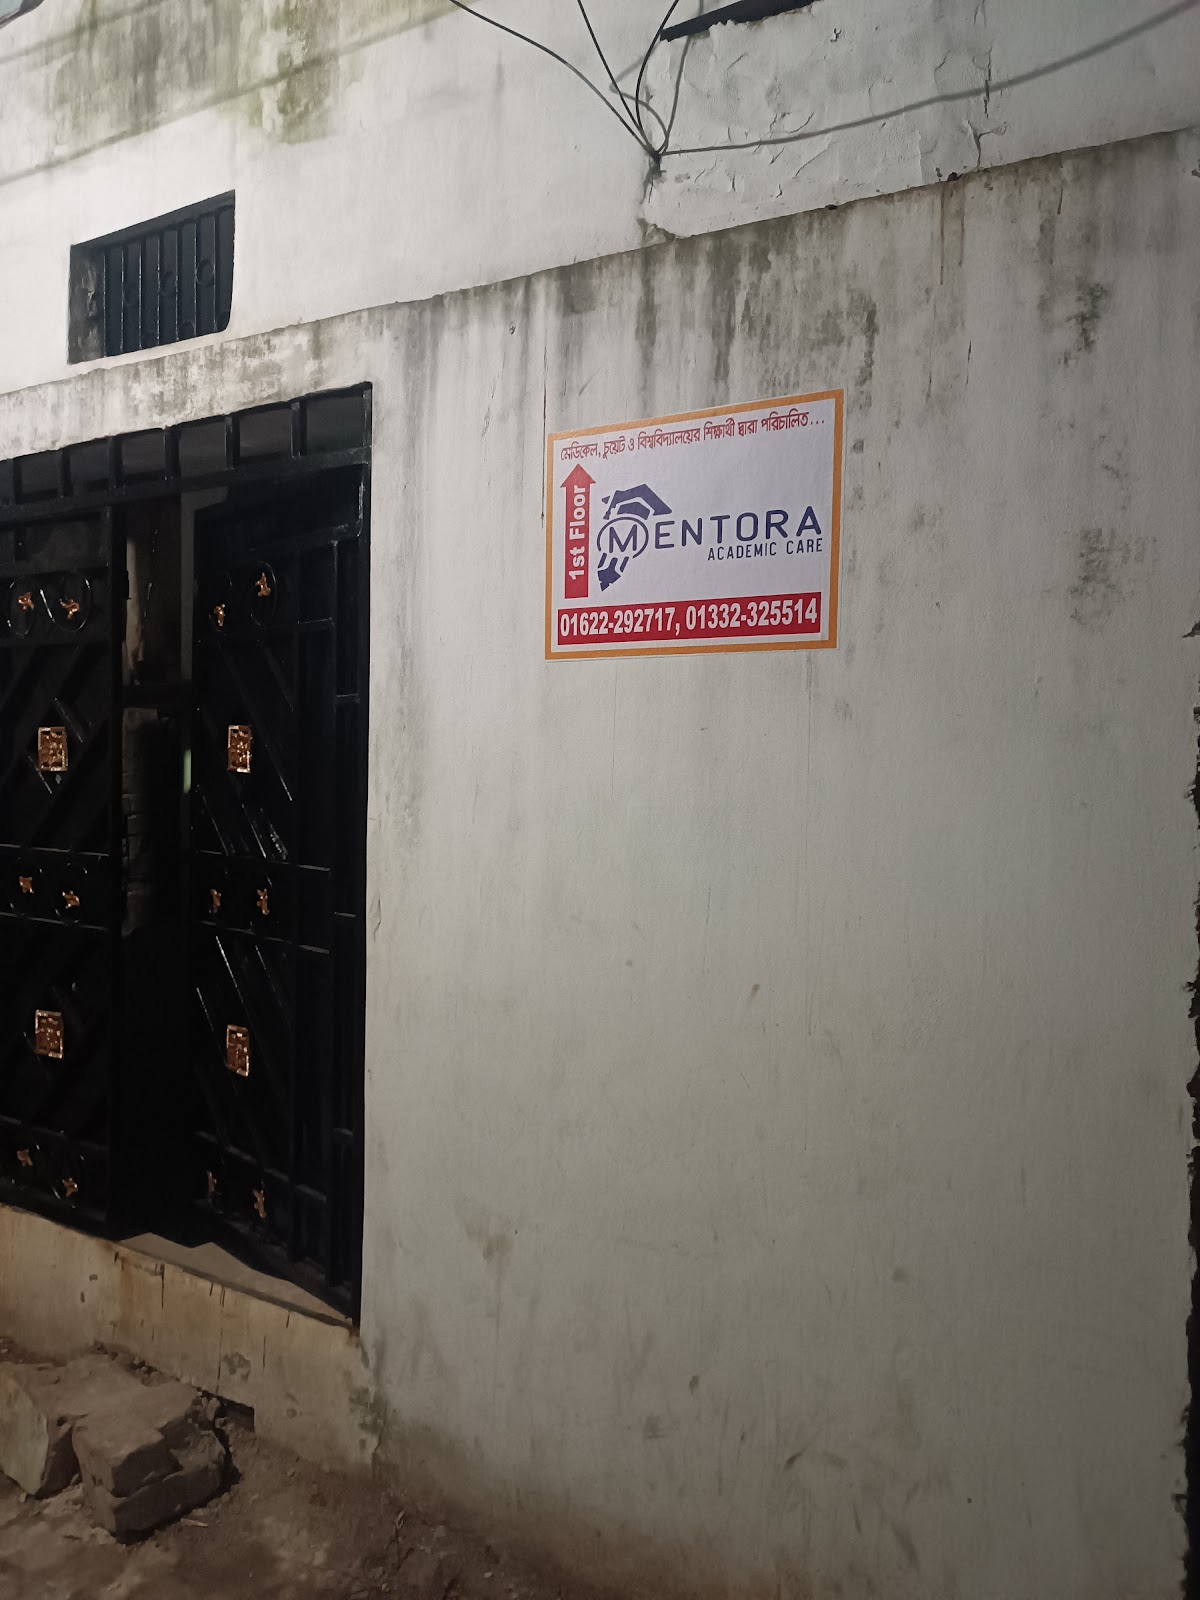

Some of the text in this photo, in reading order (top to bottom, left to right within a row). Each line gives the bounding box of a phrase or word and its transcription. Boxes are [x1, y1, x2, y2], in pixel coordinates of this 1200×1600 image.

[628, 438, 635, 451] ও
[738, 420, 758, 437] দ্বারা
[568, 485, 587, 580] 1st Floor
[707, 538, 823, 561] ACADEMIC CARE
[560, 597, 818, 637] 01622-292717, 01332-325514
